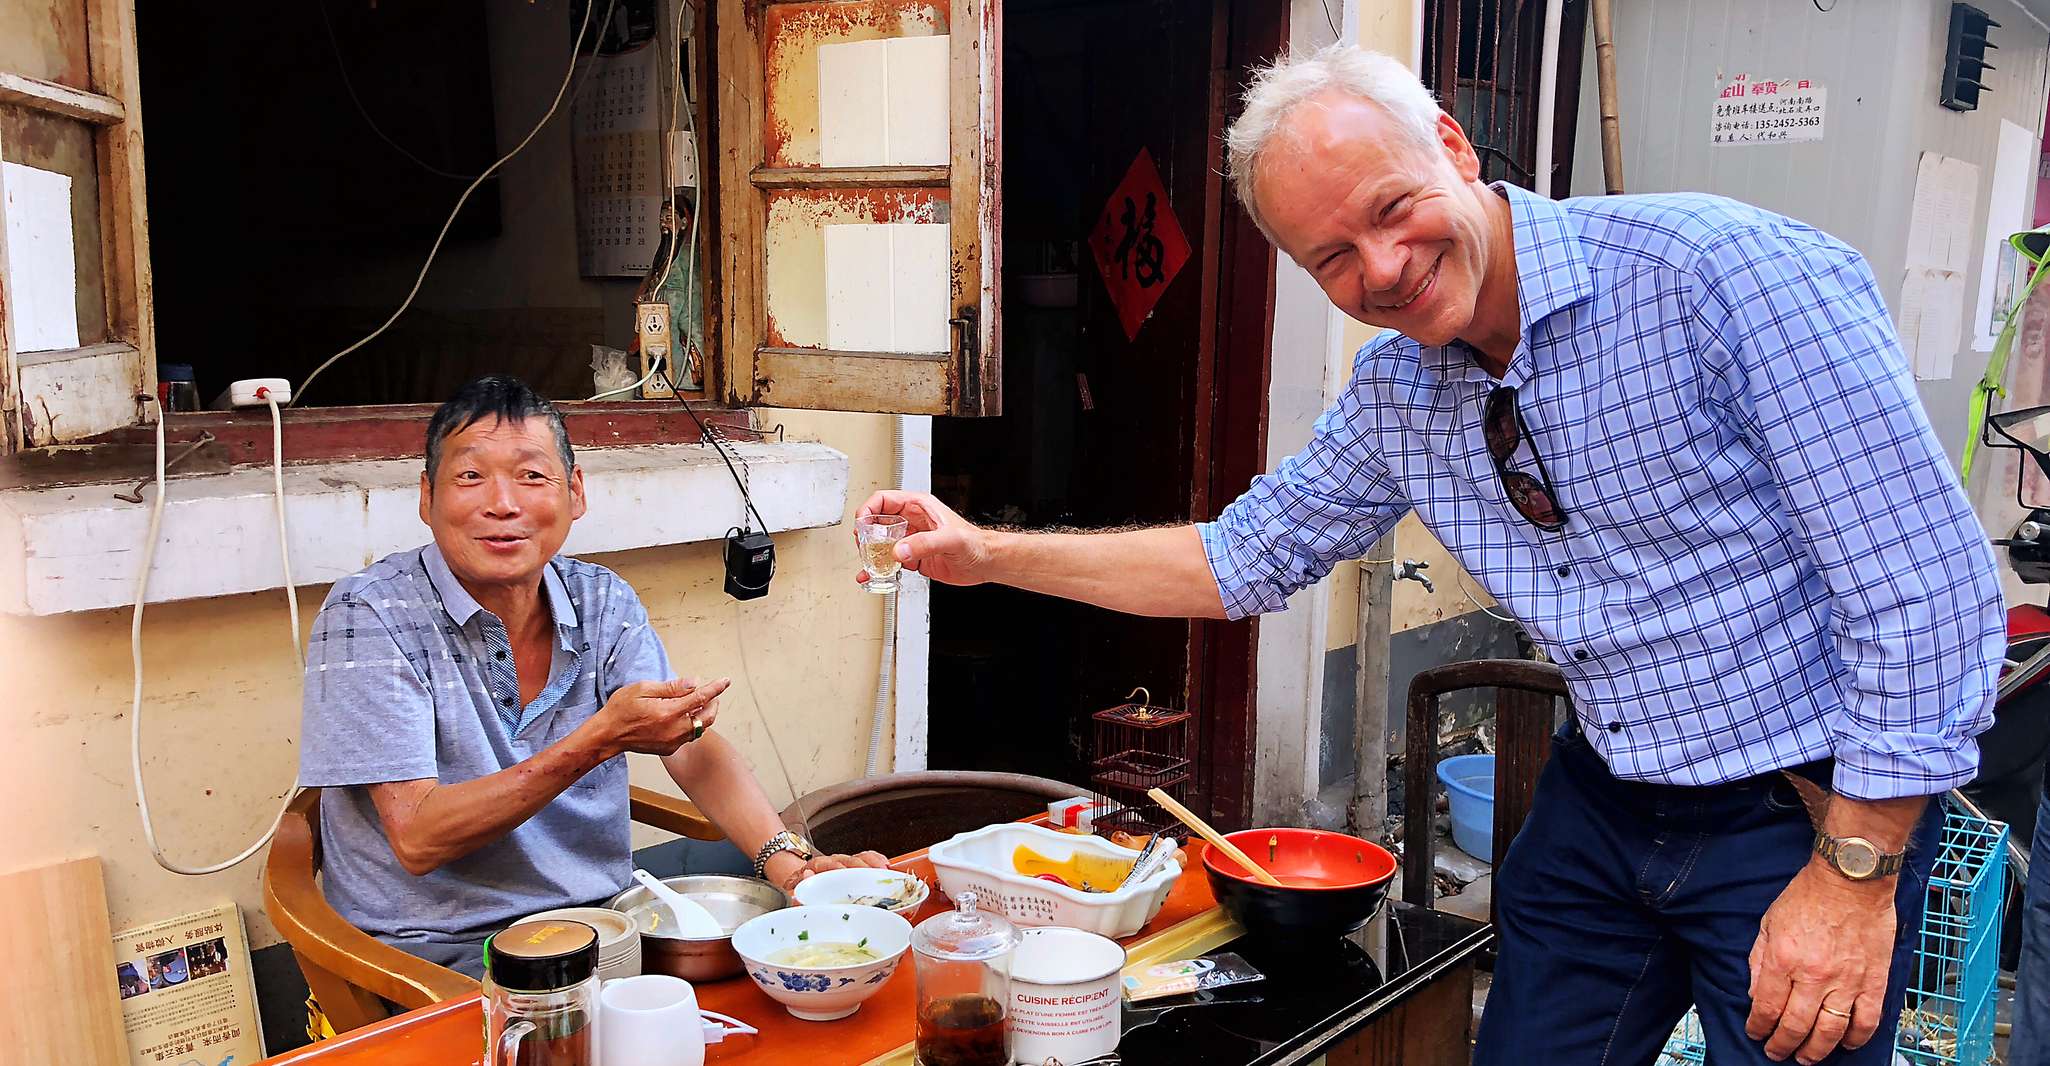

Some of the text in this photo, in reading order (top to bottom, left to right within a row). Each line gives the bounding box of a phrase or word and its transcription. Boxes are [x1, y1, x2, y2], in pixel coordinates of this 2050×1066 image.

[1755, 117, 1820, 130] 135-2452-5363
[185, 922, 223, 940] 体贴服务
[135, 935, 175, 953] 入微物管
[1017, 994, 1059, 1006] CUISINE
[203, 1027, 241, 1046] 闻香而来
